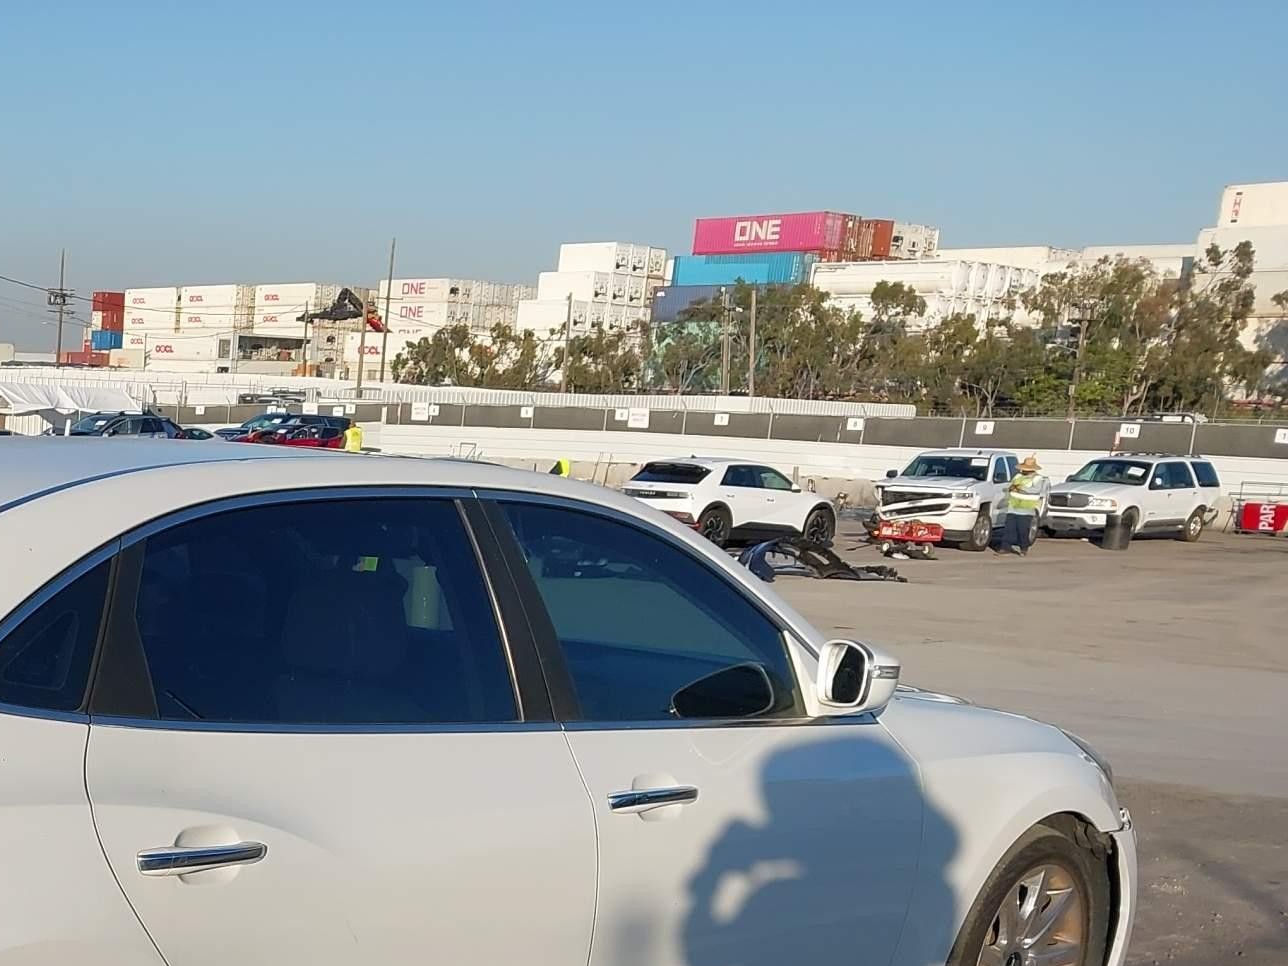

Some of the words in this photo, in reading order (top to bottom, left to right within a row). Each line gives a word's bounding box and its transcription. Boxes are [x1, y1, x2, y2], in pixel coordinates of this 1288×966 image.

[734, 219, 781, 241] ONE
[401, 282, 426, 295] ONE
[400, 305, 424, 318] ONE
[155, 345, 175, 353] OOCL
